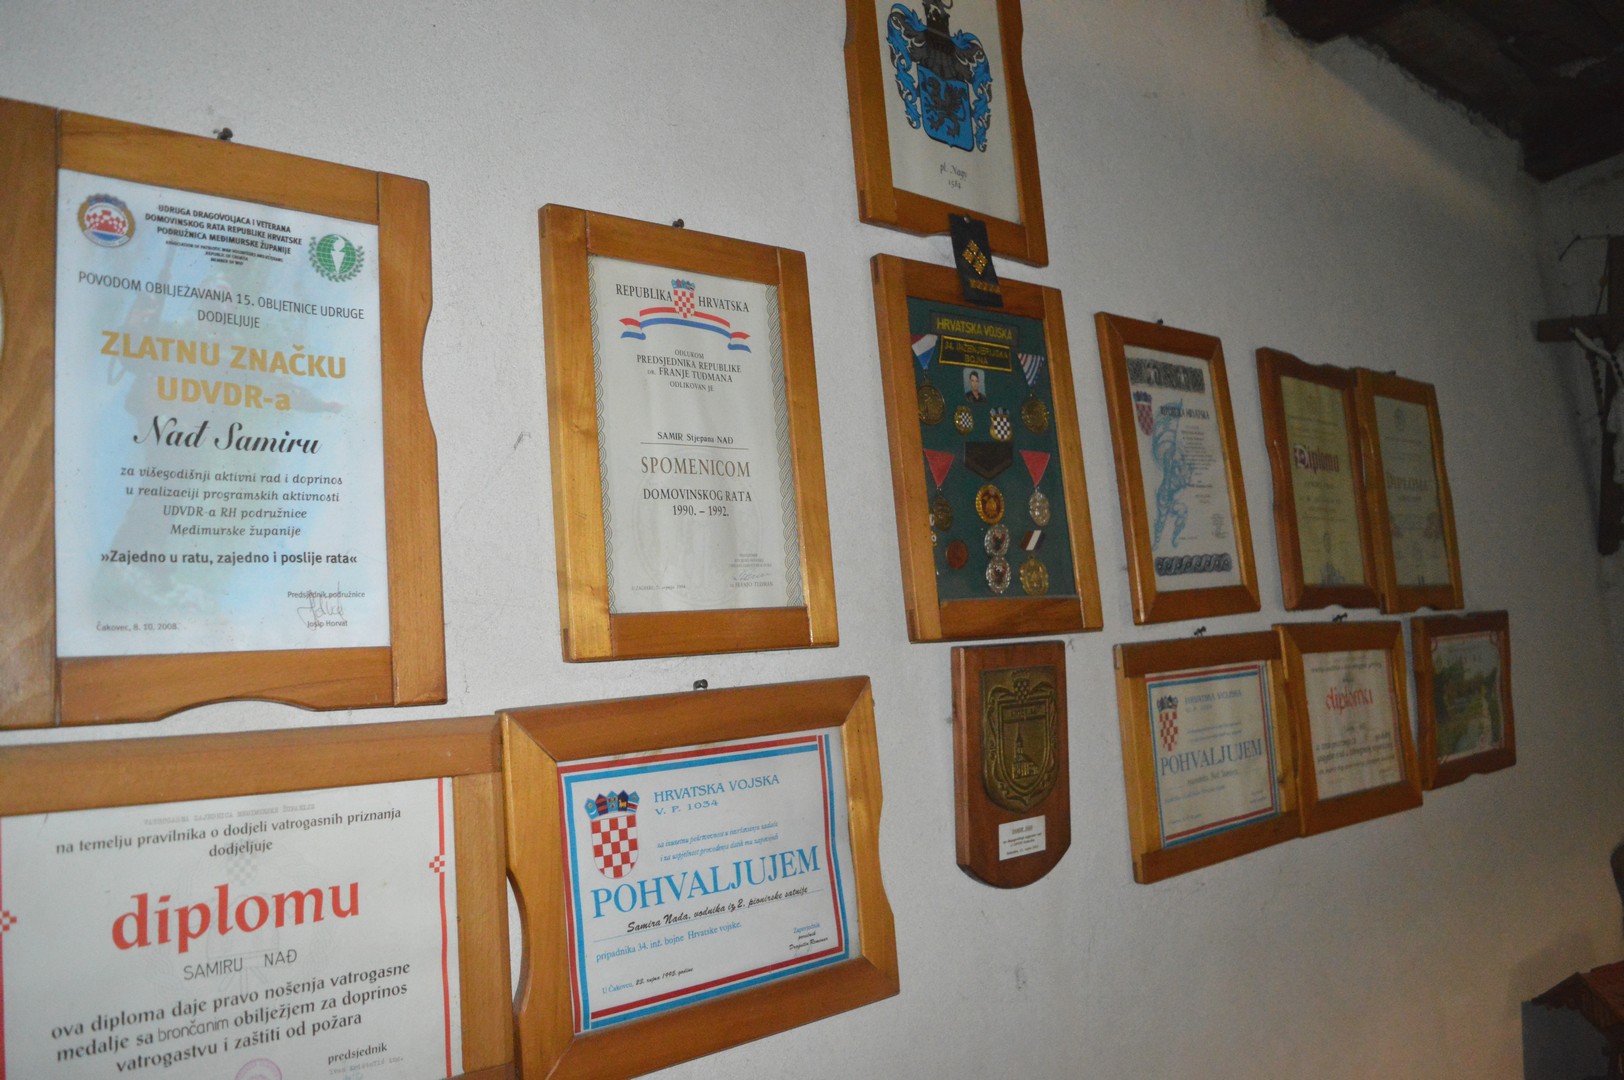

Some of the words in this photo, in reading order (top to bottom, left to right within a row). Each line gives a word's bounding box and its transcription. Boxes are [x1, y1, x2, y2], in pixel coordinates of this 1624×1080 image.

[145, 213, 204, 228] DOMOVINSKOG
[206, 222, 225, 231] RATA
[227, 225, 265, 238] REPUBLIKE
[268, 232, 302, 245] HRVATSKE
[158, 204, 191, 216] UDRUGA
[193, 210, 250, 225] DRAGOVOLJACA
[256, 220, 291, 233] VETERANA
[157, 226, 207, 240] PODRUŽNICA
[209, 235, 258, 248] MEĐIMURSKE
[260, 240, 291, 255] ŽUPANIJE
[78, 270, 141, 292] POVODOM
[145, 281, 232, 303] OBILJEŽAVANJA
[237, 294, 255, 307] 15.
[258, 296, 317, 316] OBLJETNICE
[320, 306, 365, 320] UDRUGE
[616, 283, 672, 302] REPUBLIKA
[698, 296, 749, 312] HRVATSKA
[197, 310, 260, 329] DODJELJUJE
[937, 317, 982, 334] HRVATSKA
[984, 325, 1013, 340] VOJSKA
[100, 331, 220, 367] ZLATNU
[230, 344, 347, 379] ZNAČKU
[637, 355, 696, 369] PREDSJEDNIKA
[699, 361, 742, 373] REPUBLIKE
[675, 350, 704, 359] ODLUKOM
[659, 368, 690, 379] FRANJE
[692, 371, 732, 383] TUĐMANA
[670, 381, 706, 391] ODLIKOVAN
[157, 376, 292, 411] UDVDR-a
[133, 415, 209, 448] Nađ
[214, 421, 322, 454] Samiru
[658, 432, 683, 441] SAMIR
[687, 433, 714, 443] Stjepana
[717, 436, 733, 444] NAĐ
[121, 467, 134, 476] za
[139, 466, 211, 481] višegodišnji
[215, 472, 257, 483] aktivni
[260, 474, 280, 483] rad
[292, 474, 343, 485] doprinos
[641, 456, 750, 477] SPOMENICOM
[126, 487, 133, 495] u
[138, 487, 199, 499] realizaciji
[203, 489, 278, 502] programskih
[283, 492, 340, 502] aktivnosti
[643, 488, 723, 501] DOMOVINSKOG
[725, 491, 751, 501] RATA
[221, 508, 236, 518] RH
[241, 507, 307, 520] podružnice
[673, 505, 696, 516] 1990.
[709, 506, 729, 517] 1992.
[170, 524, 245, 537] Međimurske
[250, 526, 301, 537] županije
[170, 554, 176, 563] u
[182, 552, 214, 566] ratu,
[217, 552, 269, 566] zajedno
[282, 553, 322, 566] poslije
[288, 591, 326, 599] Predsjednik
[329, 591, 365, 599] podružnice
[96, 621, 131, 632] Čakovec,
[307, 620, 324, 628] Josip
[1161, 739, 1263, 776] POHVALJUJEM
[654, 784, 725, 803] HRVATSKA
[729, 774, 780, 791] VOJSKA
[656, 807, 666, 816] V.
[672, 805, 681, 813] P.
[688, 800, 718, 811] 1034
[55, 843, 73, 856] na
[79, 835, 132, 852] temelju
[137, 827, 206, 848] pravilnika
[211, 830, 218, 839] o
[223, 820, 268, 840] dodjeli
[271, 814, 343, 832] vatrogasnih
[347, 807, 401, 826] priznanja
[208, 838, 273, 858] dodjeljuje
[591, 845, 820, 919] POHVALJUJEM
[111, 882, 359, 954] diplomu
[627, 920, 661, 933] Samira
[694, 904, 726, 919] vodnika
[738, 899, 745, 908] 2.
[748, 891, 782, 908] pionirske
[596, 945, 636, 963] pripadnika
[638, 943, 648, 952] 34.
[664, 935, 684, 947] bojne
[688, 927, 718, 940] Hrvatske
[183, 958, 243, 981] SAMIRU
[264, 949, 297, 967] NAĐ
[51, 1022, 83, 1040] ova
[91, 1009, 165, 1033] diploma
[172, 1000, 208, 1019] daje
[213, 989, 259, 1013] pravo
[265, 977, 325, 1000] nošenja
[330, 962, 411, 988] vatrogasne
[56, 1035, 129, 1063] medalje
[137, 1032, 153, 1047] sa
[157, 1018, 229, 1043] brončanim
[234, 1001, 315, 1030] obilježjem
[320, 997, 337, 1011] za
[342, 982, 408, 1007] doprinos
[116, 1042, 218, 1072] vatrogastvu
[234, 1028, 281, 1050] zaštiti
[286, 1021, 306, 1038] od
[311, 1013, 362, 1037] požara
[328, 1042, 388, 1065] predsjednik
